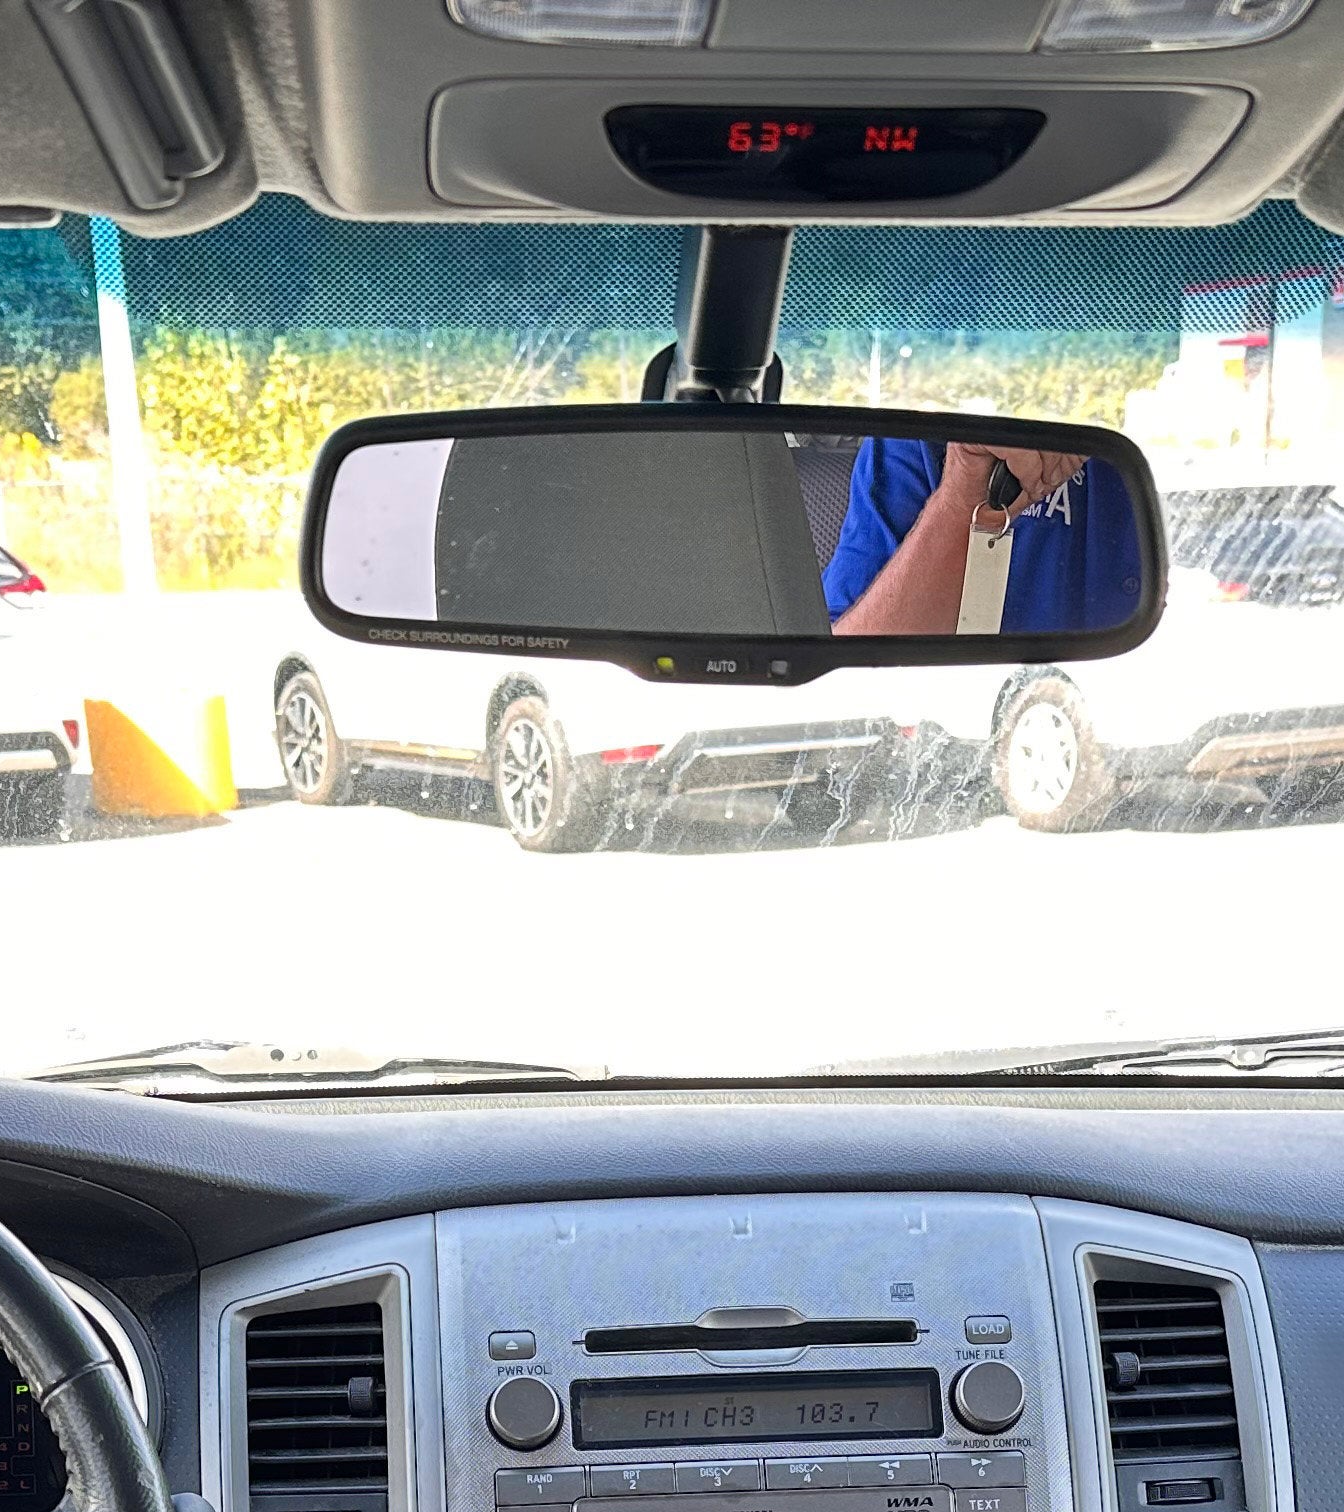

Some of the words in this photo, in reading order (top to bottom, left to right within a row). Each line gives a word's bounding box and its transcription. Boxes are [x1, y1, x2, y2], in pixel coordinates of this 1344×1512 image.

[864, 126, 918, 152] NW
[368, 628, 407, 641] CHECK
[410, 629, 499, 646] SURROUNDINGS
[501, 635, 525, 648] FOR
[527, 636, 570, 649] SAFETY
[706, 660, 737, 673] AUTO
[972, 1324, 1005, 1335] LOAD
[956, 1351, 980, 1361] TUNE
[984, 1349, 1005, 1360] FILE
[497, 1366, 524, 1377] PWR
[527, 1365, 549, 1375] VOL
[16, 1385, 29, 1395] P
[17, 1404, 29, 1413] R
[644, 1409, 689, 1429] FM1
[703, 1405, 755, 1429] CH3
[795, 1401, 880, 1426] 103.7
[17, 1423, 30, 1433] N
[963, 1438, 990, 1449] AUDIO
[992, 1437, 1033, 1449] CONTROL
[700, 1467, 721, 1477] DISC
[789, 1464, 810, 1474] DISC
[977, 1467, 986, 1477] 6
[527, 1474, 553, 1484] RAND
[623, 1471, 641, 1480] RPT
[803, 1473, 812, 1483] 4
[887, 1470, 895, 1480] 5
[629, 1480, 638, 1490] 2
[713, 1476, 722, 1487] 3
[537, 1485, 544, 1494] 1
[887, 1497, 933, 1508] WMA
[969, 1499, 1001, 1511] TEXT
